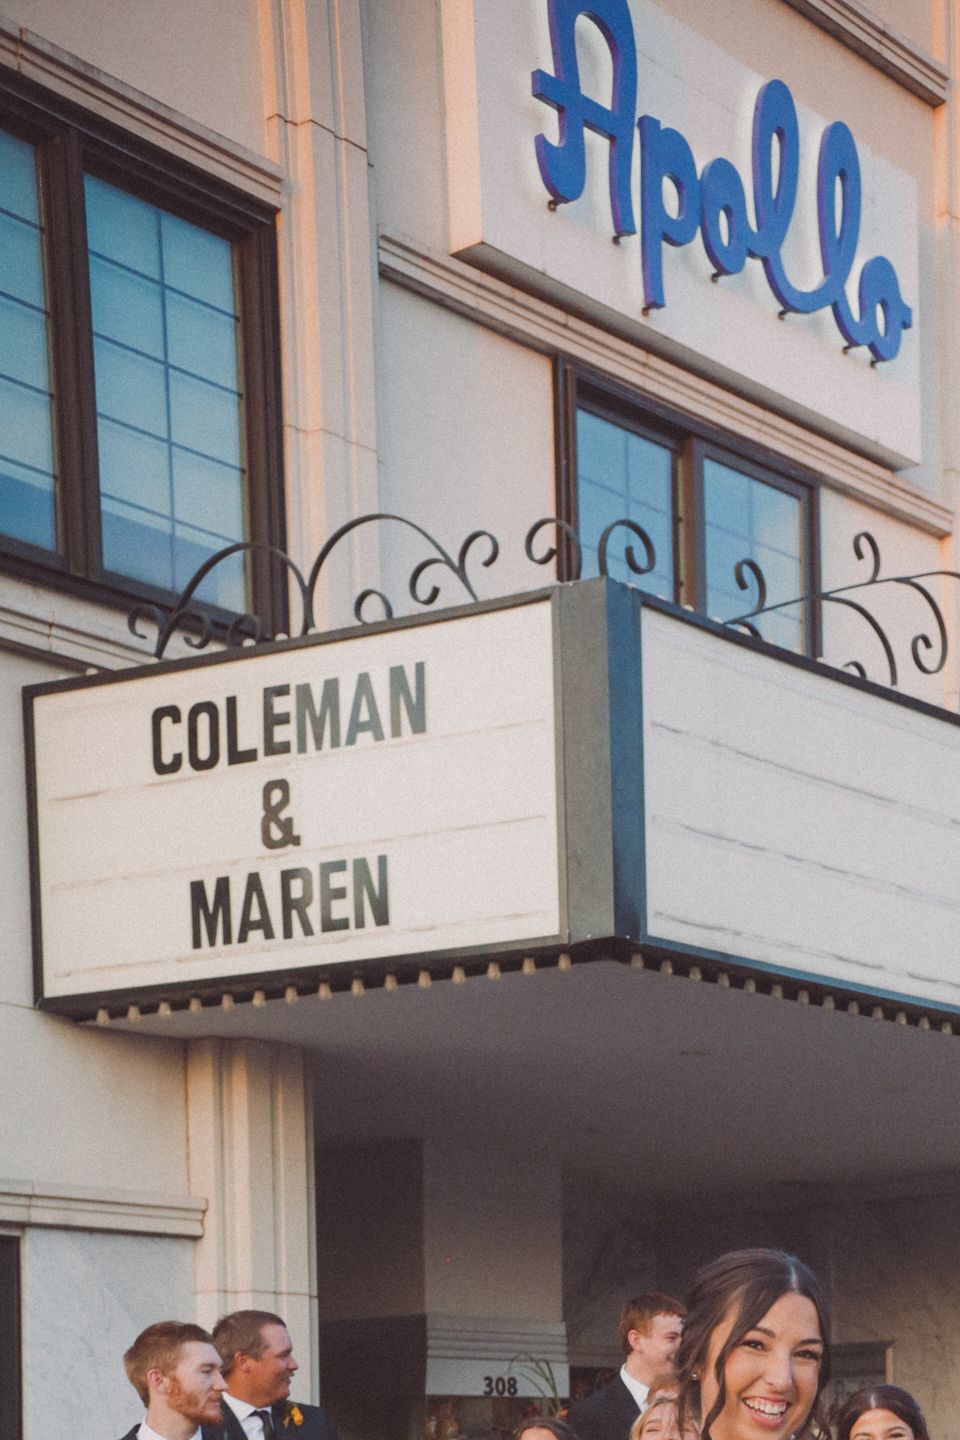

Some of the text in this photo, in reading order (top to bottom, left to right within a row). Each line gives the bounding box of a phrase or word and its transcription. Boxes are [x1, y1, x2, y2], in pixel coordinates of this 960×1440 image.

[531, 0, 912, 361] Apollo
[151, 661, 427, 776] COLEMAN
[260, 778, 301, 850] &
[189, 854, 390, 950] MAREN
[483, 1375, 518, 1397] 308
